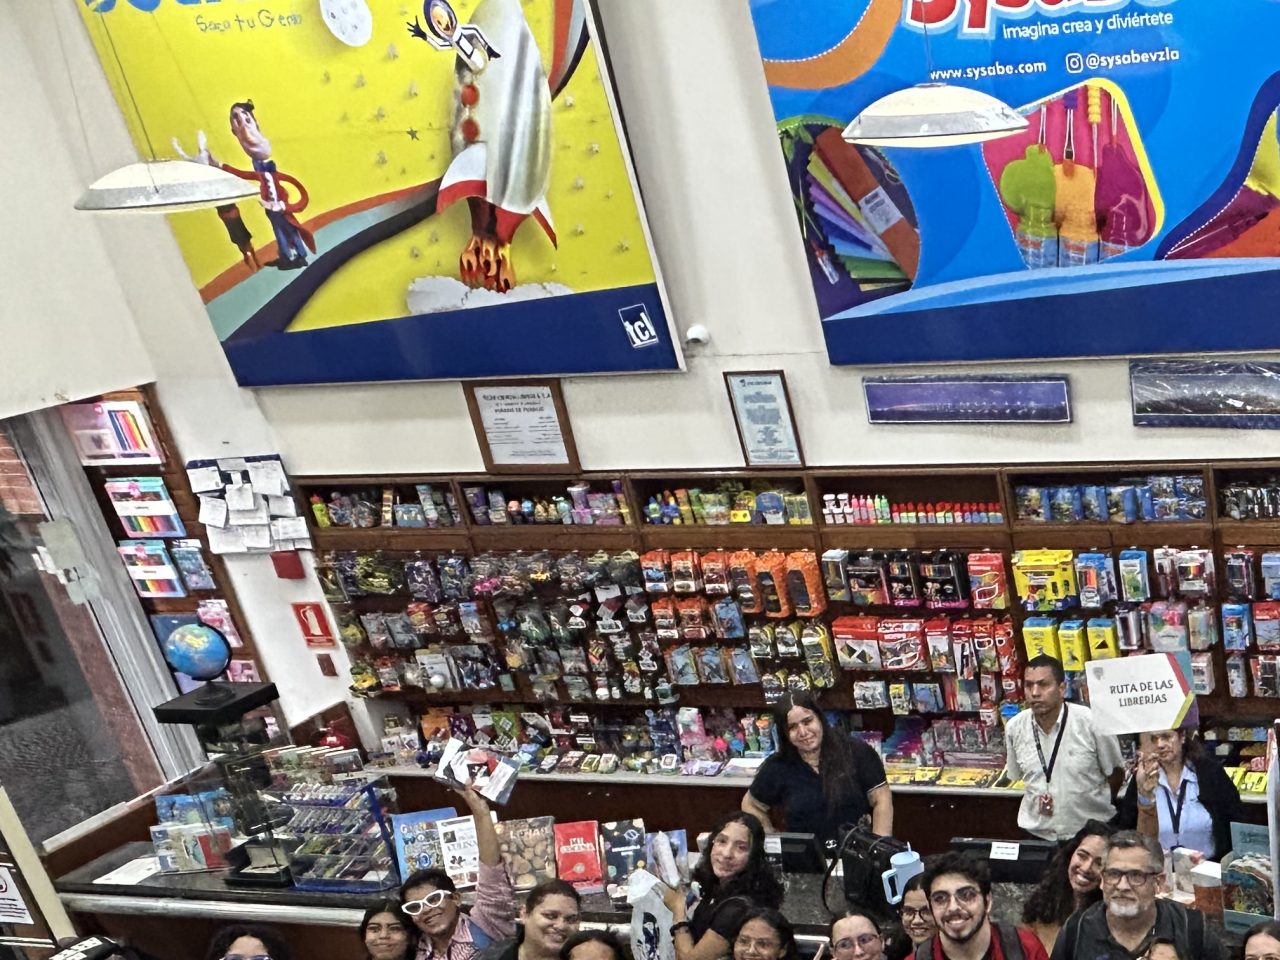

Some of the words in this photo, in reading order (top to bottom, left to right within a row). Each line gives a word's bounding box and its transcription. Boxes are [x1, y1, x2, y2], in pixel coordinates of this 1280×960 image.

[1064, 20, 1093, 34] crea
[1095, 20, 1104, 35] y
[1106, 11, 1174, 31] diviértete
[930, 59, 1047, 81] www.sysabe.com
[1086, 47, 1180, 70] @sysabevzla
[624, 312, 657, 348] tcl
[1110, 684, 1138, 694] RUTA
[1140, 681, 1154, 692] DE
[1155, 680, 1173, 690] LAS
